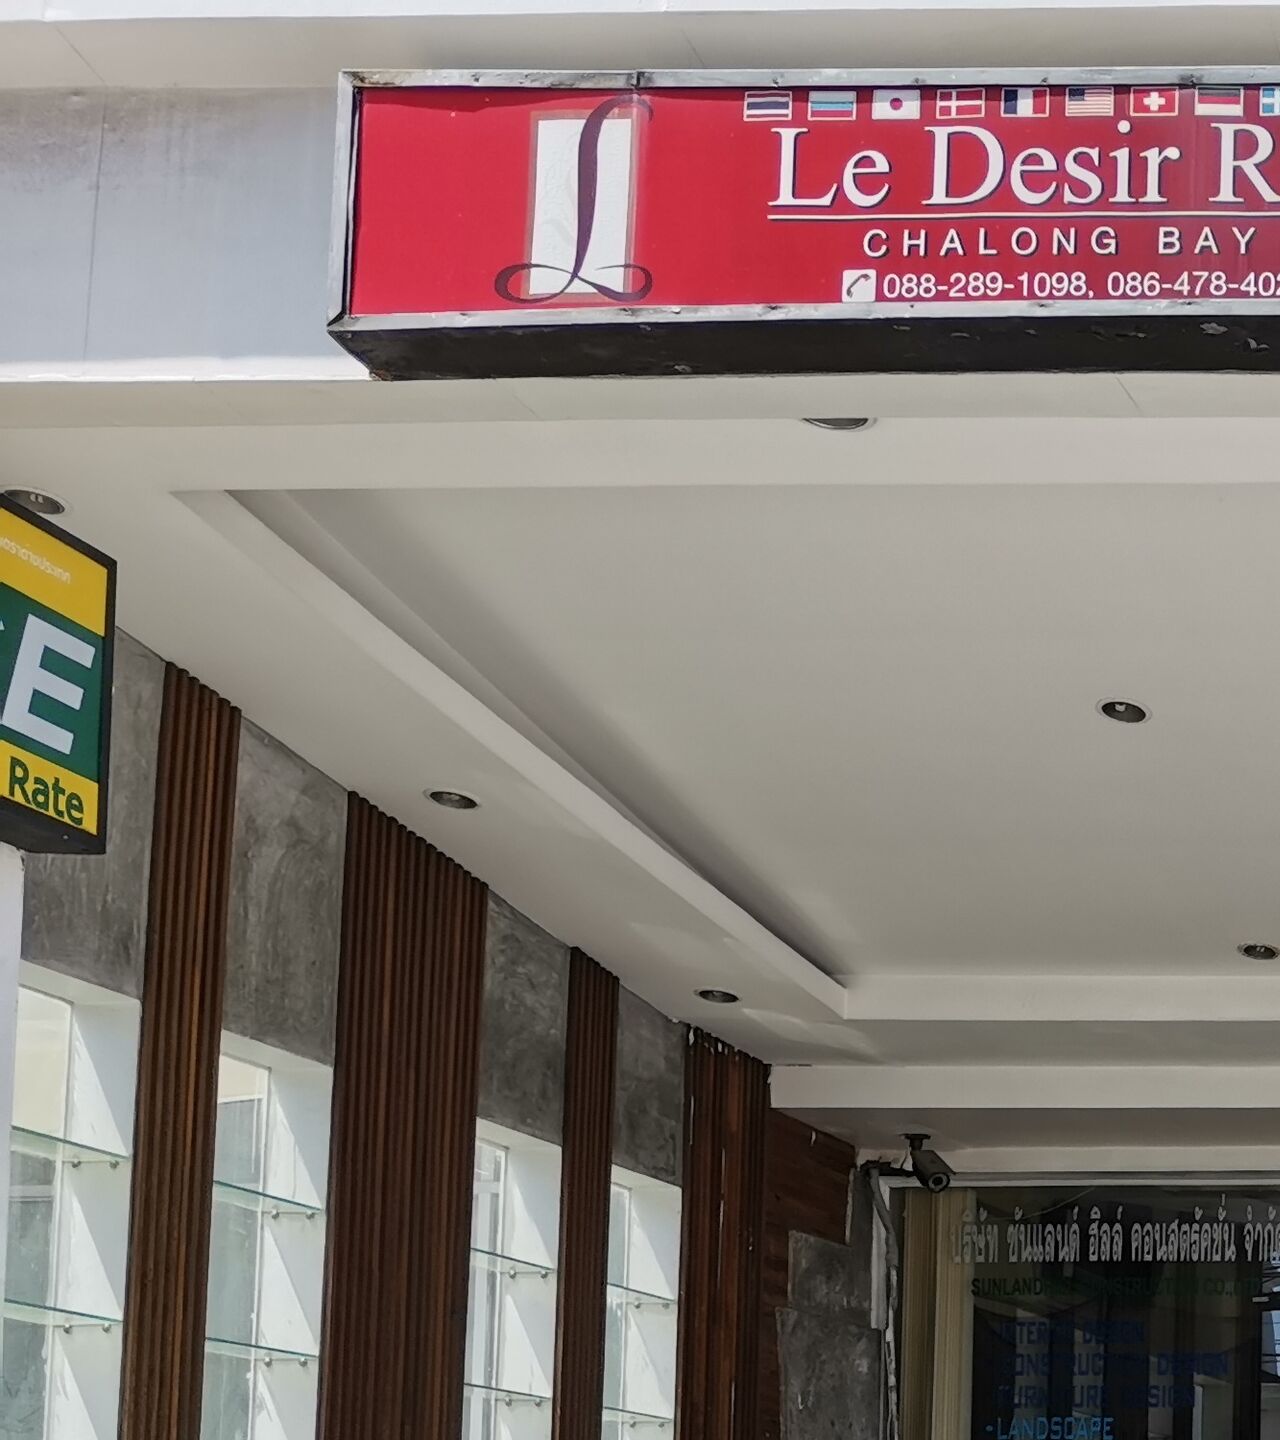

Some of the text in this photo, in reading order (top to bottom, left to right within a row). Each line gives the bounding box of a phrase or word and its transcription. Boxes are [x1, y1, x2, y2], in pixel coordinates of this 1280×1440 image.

[768, 127, 890, 208] Le
[924, 119, 1180, 207] Desir
[862, 228, 1119, 257] CHALONG
[1157, 225, 1257, 255] BAY
[883, 271, 1096, 301] 088-289-1098,
[8, 755, 85, 827] Rate
[971, 1277, 1043, 1297] SUNLAND
[997, 1417, 1115, 1440] LANDSCAPE
